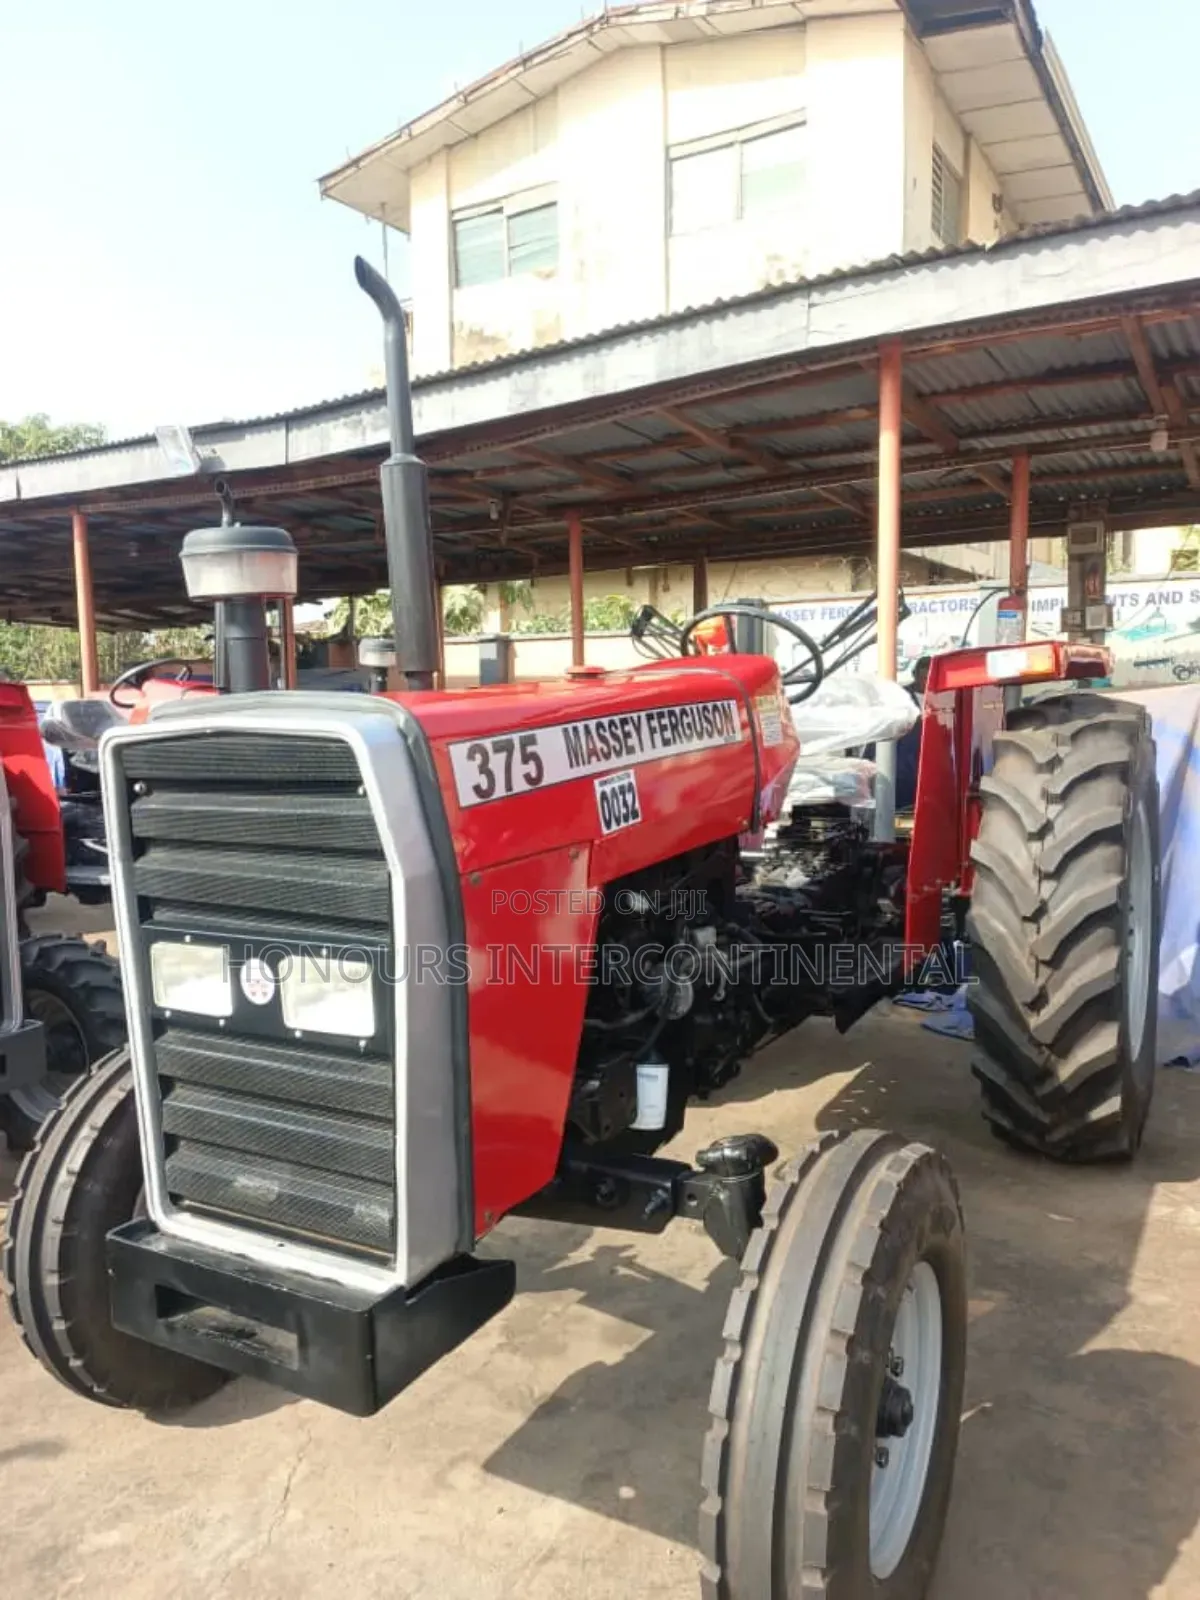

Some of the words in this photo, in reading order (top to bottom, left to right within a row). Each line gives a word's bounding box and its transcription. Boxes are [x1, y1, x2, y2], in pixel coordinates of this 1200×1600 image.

[775, 608, 817, 622] ASSEY
[907, 597, 979, 615] RACTORS
[1145, 590, 1184, 606] AND
[466, 733, 544, 800] 375
[562, 714, 647, 769] MASSEY
[647, 702, 736, 749] FERGUSON
[599, 781, 640, 831] 0032
